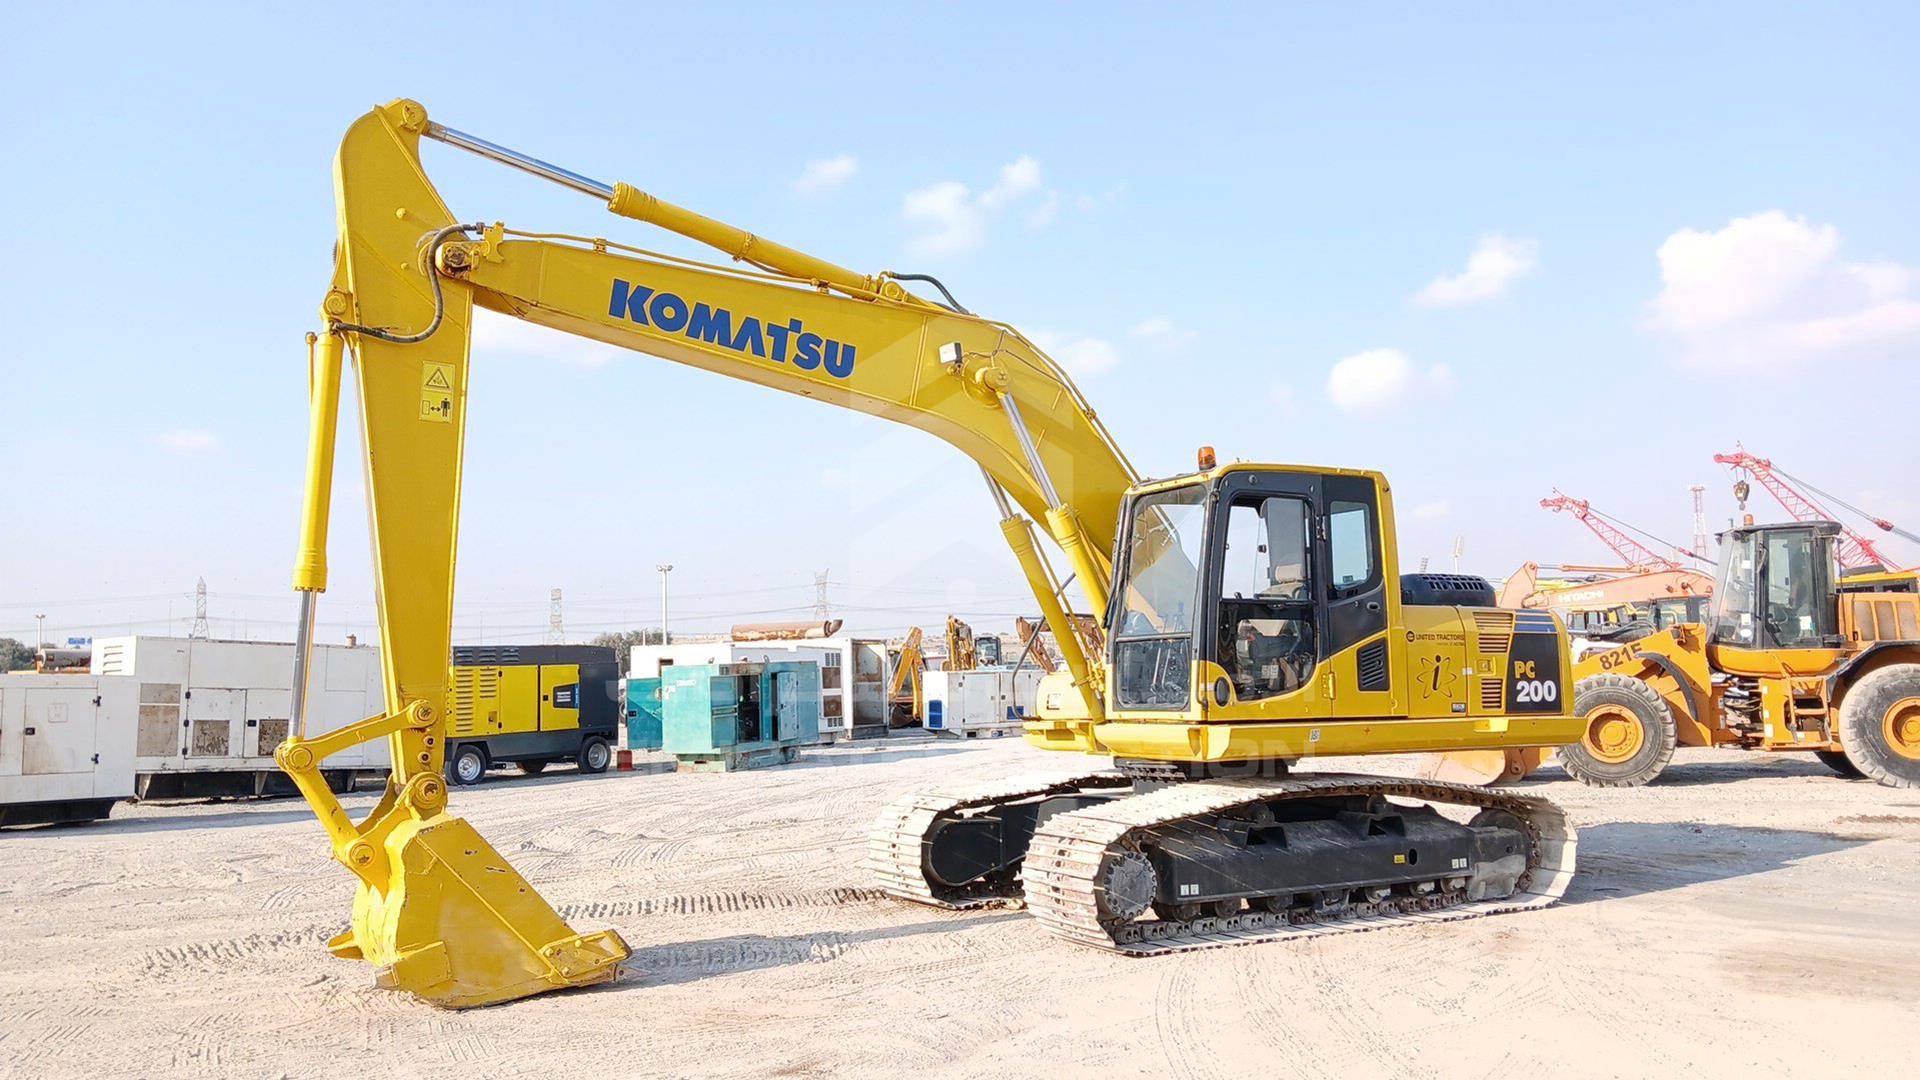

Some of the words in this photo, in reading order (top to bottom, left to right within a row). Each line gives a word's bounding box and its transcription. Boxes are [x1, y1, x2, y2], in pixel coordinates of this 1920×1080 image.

[608, 278, 857, 378] KOMATSU
[1415, 633, 1435, 641] UNITED
[1436, 633, 1465, 641] TRACTORS
[1514, 660, 1536, 679] PC
[1516, 680, 1556, 702] 200
